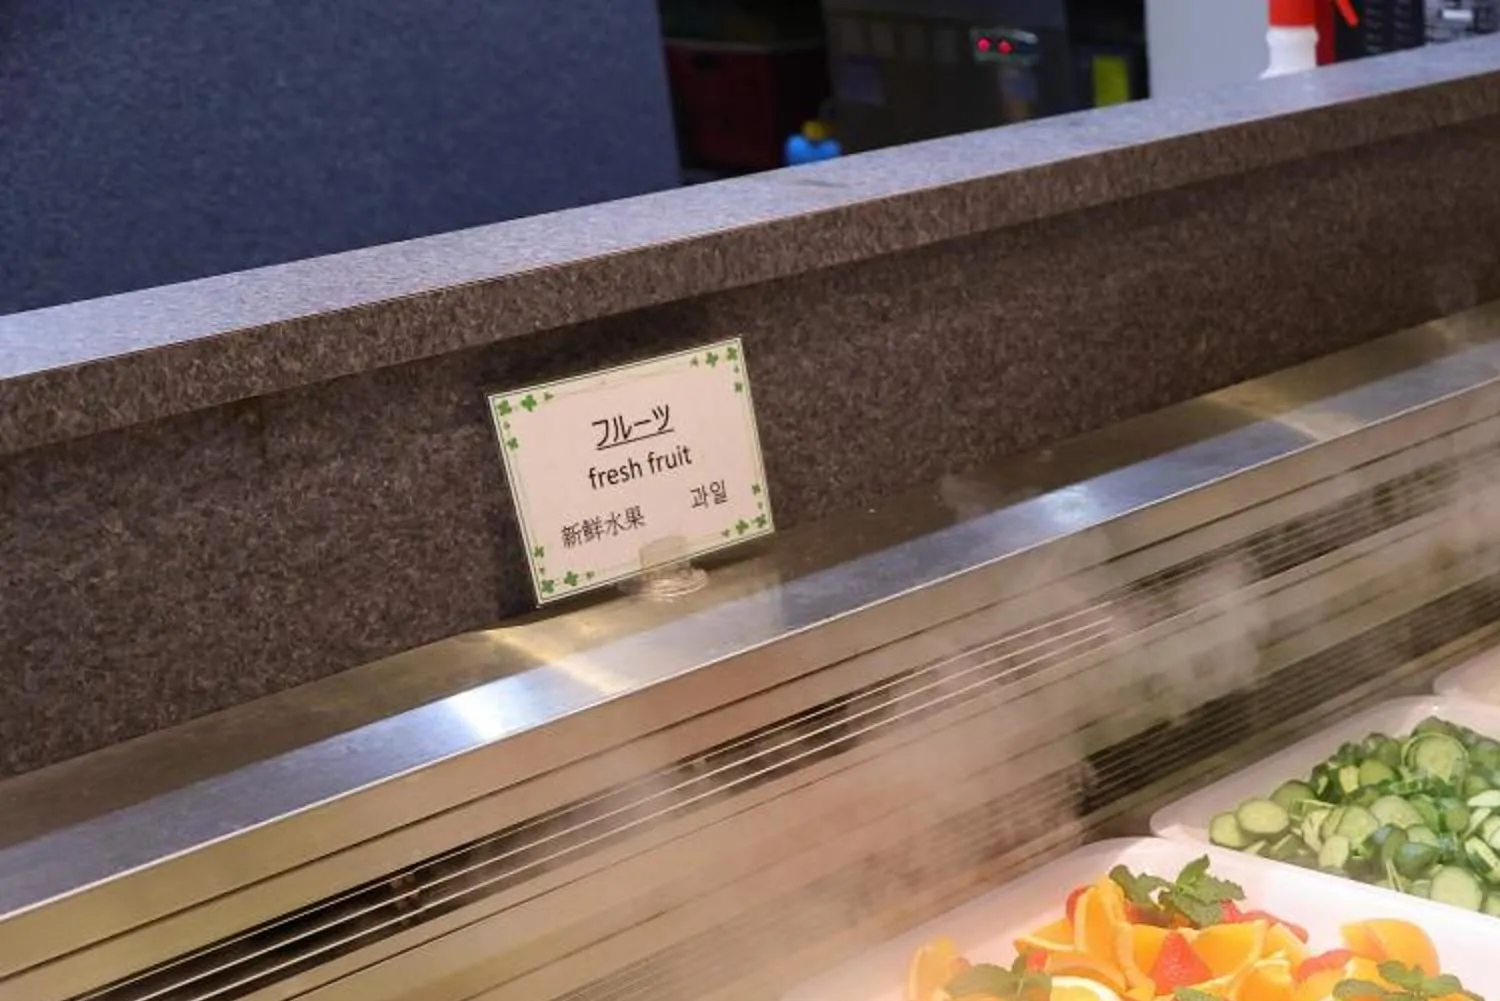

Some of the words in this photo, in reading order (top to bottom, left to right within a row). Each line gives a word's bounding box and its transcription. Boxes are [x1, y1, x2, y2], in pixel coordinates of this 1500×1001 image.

[592, 404, 671, 447] フルーツ
[588, 457, 643, 490] fresh
[648, 445, 693, 475] fruit
[690, 480, 728, 509] 과일
[561, 505, 647, 548] 新鮮水果
